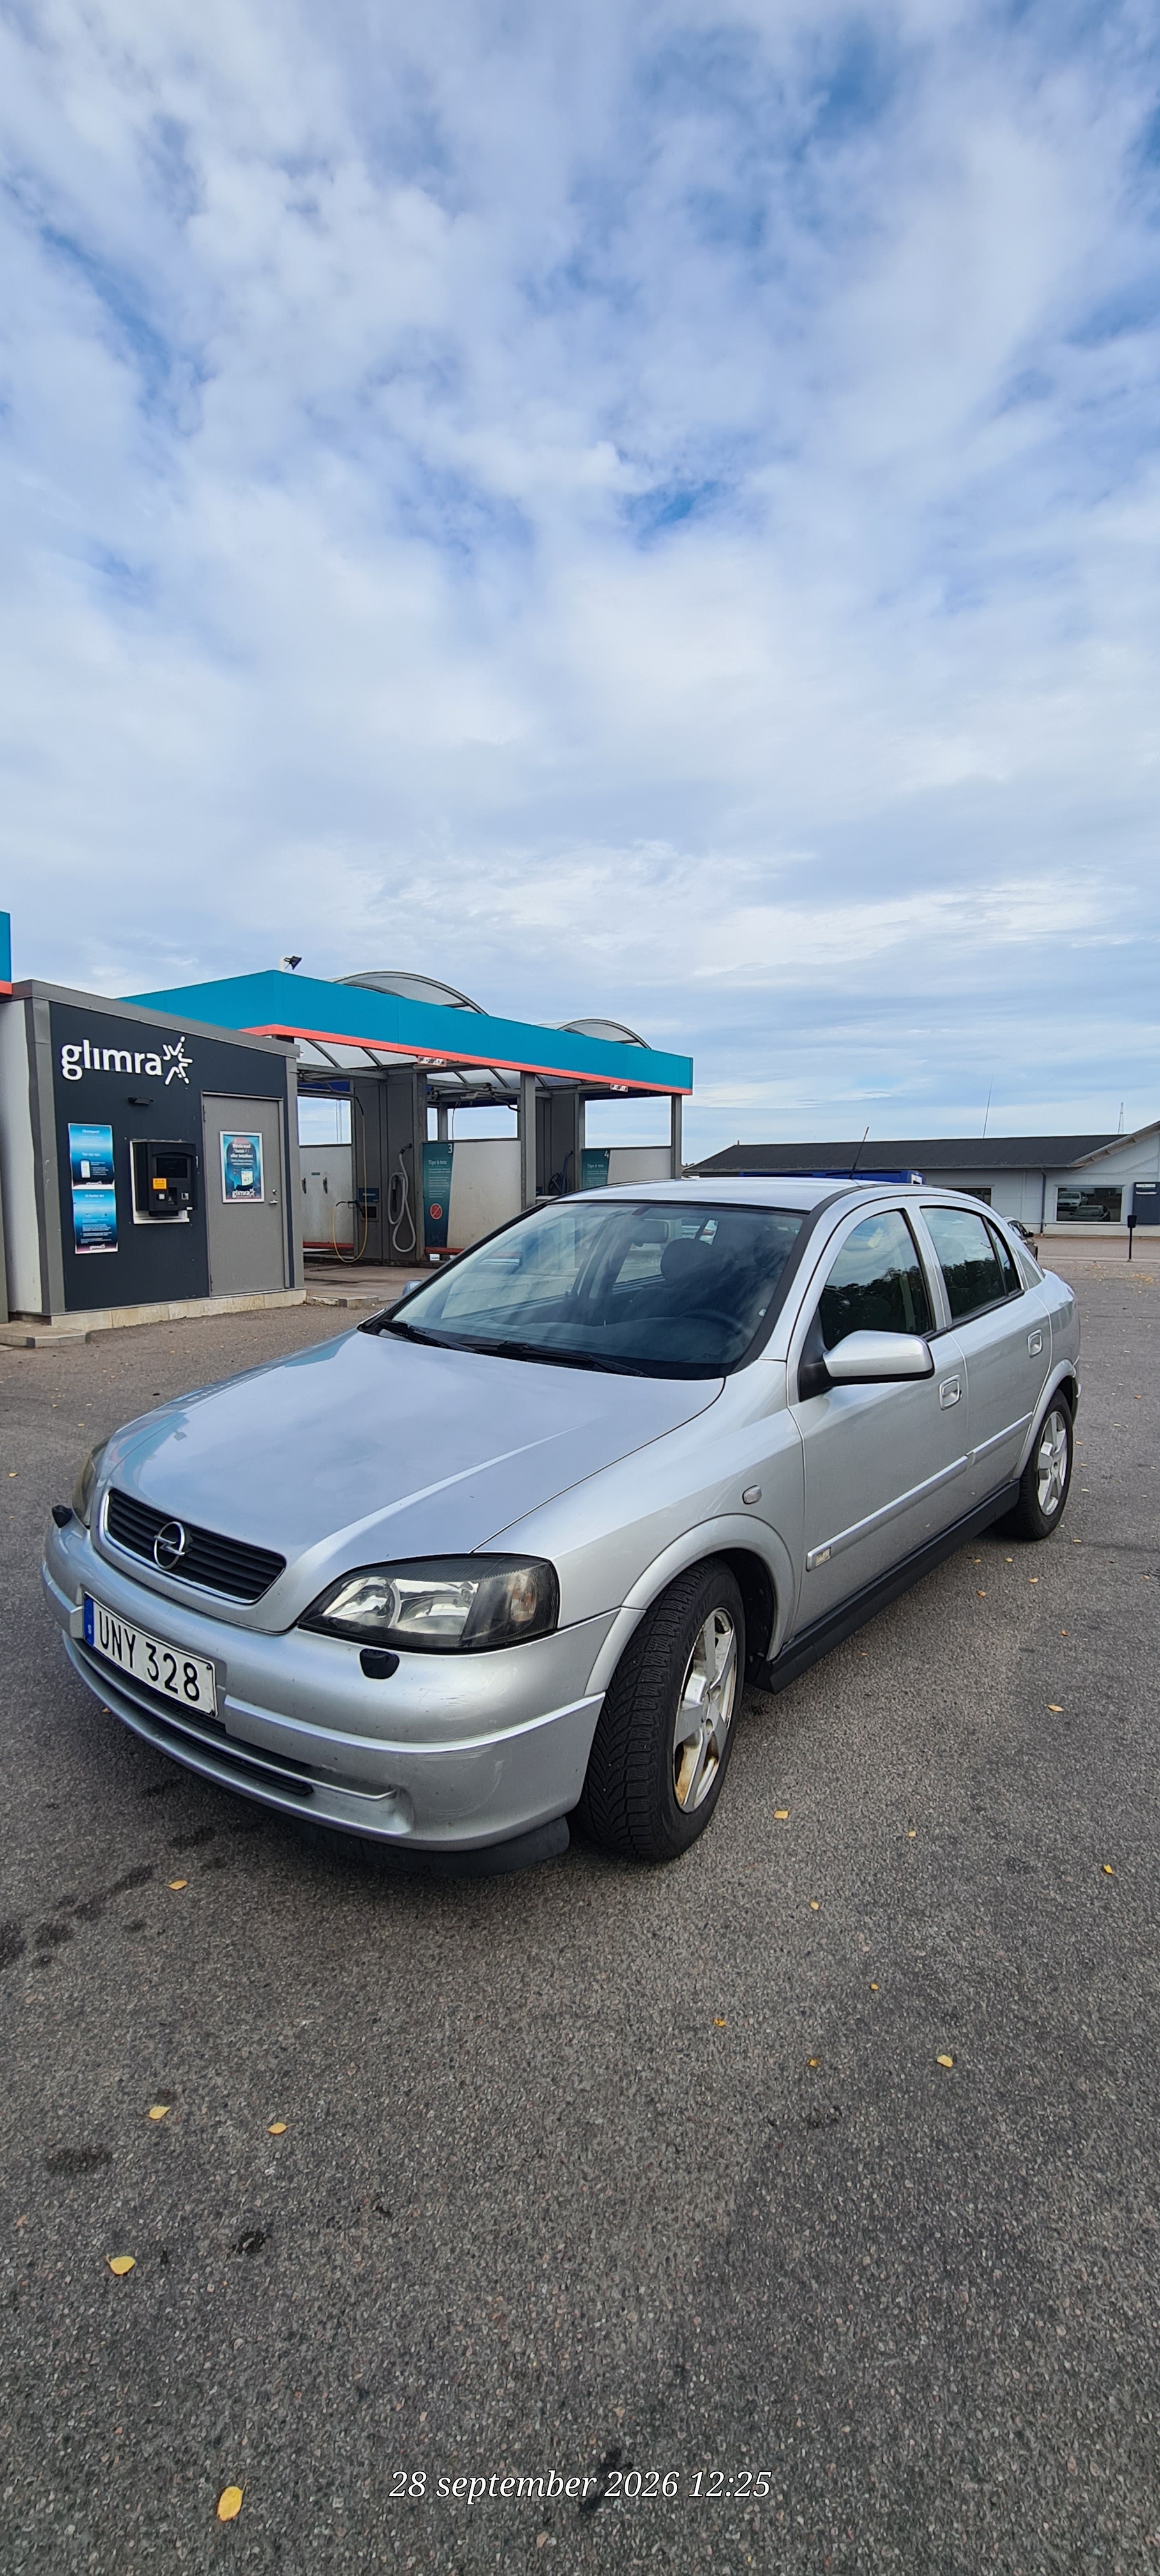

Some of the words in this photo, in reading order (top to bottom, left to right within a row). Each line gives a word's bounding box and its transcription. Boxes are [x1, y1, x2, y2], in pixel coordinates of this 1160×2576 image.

[61, 1039, 162, 1080] glimra
[448, 1143, 453, 1154] 3
[604, 1150, 609, 1159] 4
[88, 1624, 92, 1634] S
[98, 1610, 136, 1669] UNY
[145, 1641, 200, 1701] 328
